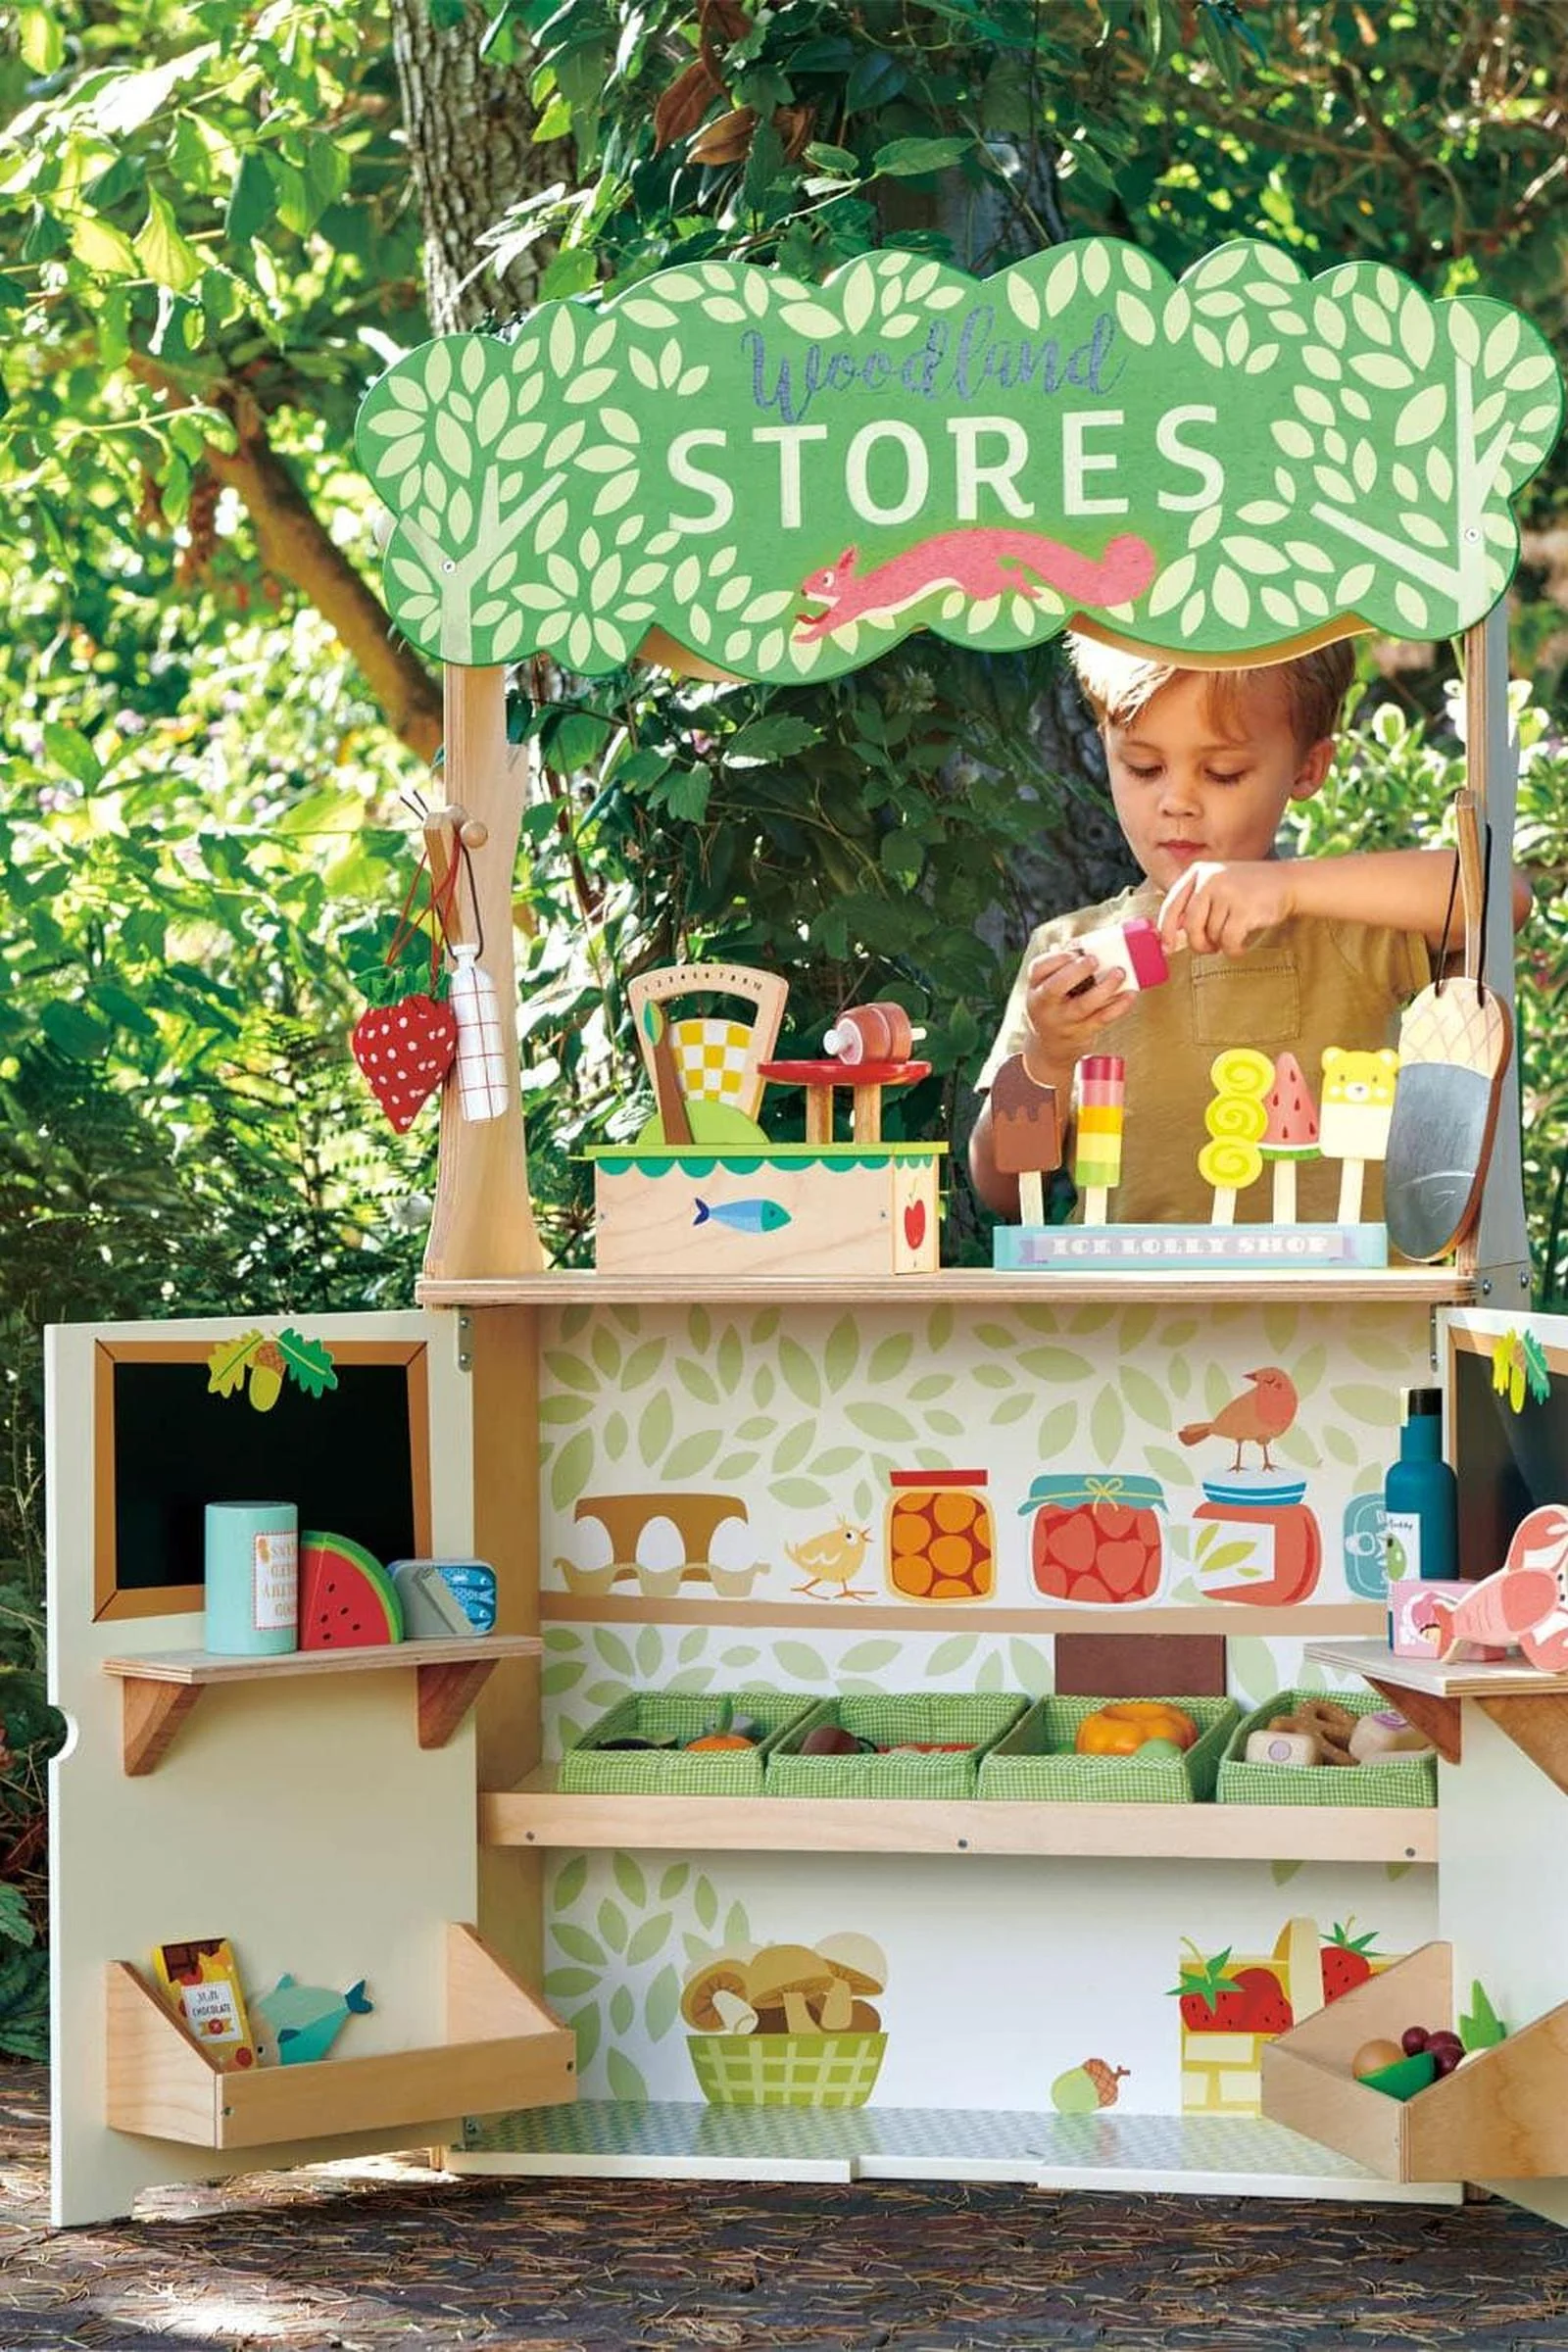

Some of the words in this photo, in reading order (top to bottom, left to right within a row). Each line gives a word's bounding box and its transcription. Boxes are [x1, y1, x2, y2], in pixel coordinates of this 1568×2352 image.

[740, 305, 1127, 424] Woodland
[666, 404, 1226, 534] STORES
[1053, 1238, 1111, 1255] ICE
[1121, 1237, 1227, 1255] LOLLY
[1238, 1235, 1329, 1254] SHOP
[192, 2002, 231, 2018] CHOCOLATE
